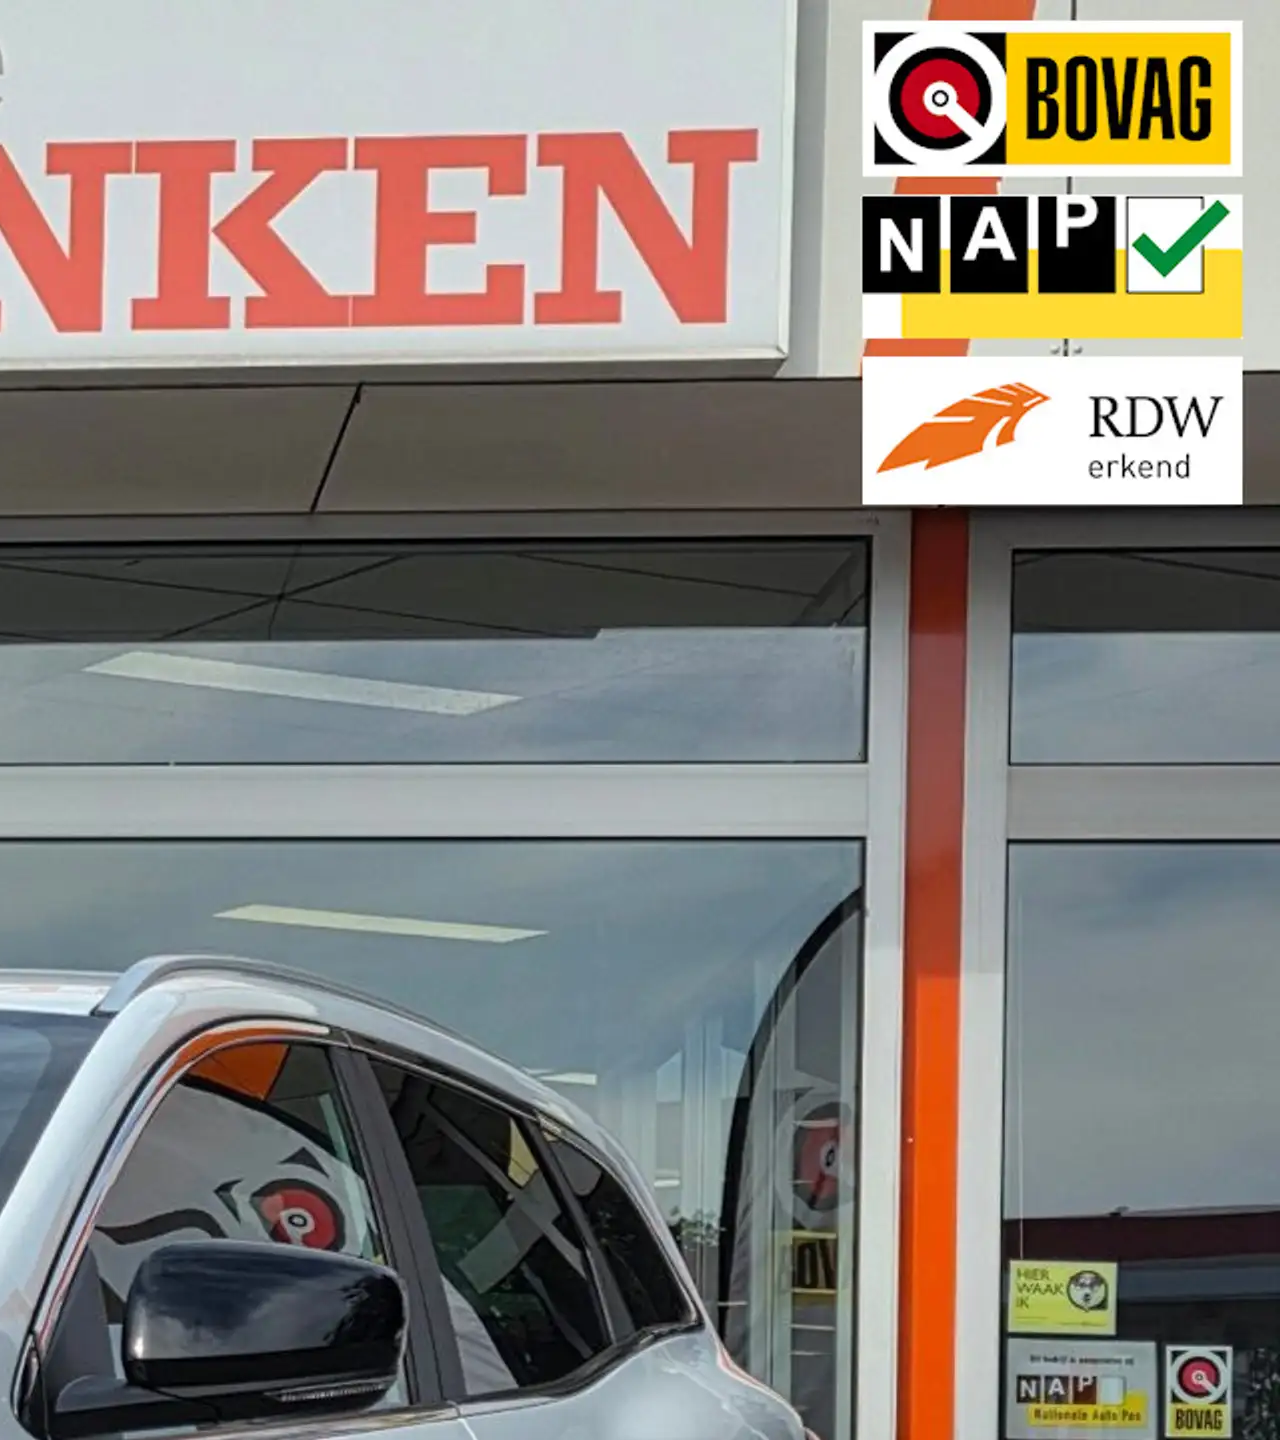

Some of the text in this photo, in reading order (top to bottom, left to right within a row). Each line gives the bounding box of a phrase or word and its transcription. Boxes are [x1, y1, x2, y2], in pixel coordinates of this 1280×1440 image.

[1017, 1268, 1049, 1280] HIER
[1016, 1283, 1064, 1295] WAAK
[1016, 1296, 1029, 1308] IK
[1020, 1376, 1093, 1397] NAP
[1092, 1408, 1118, 1420] Auto
[1175, 1409, 1223, 1430] BOVAG
